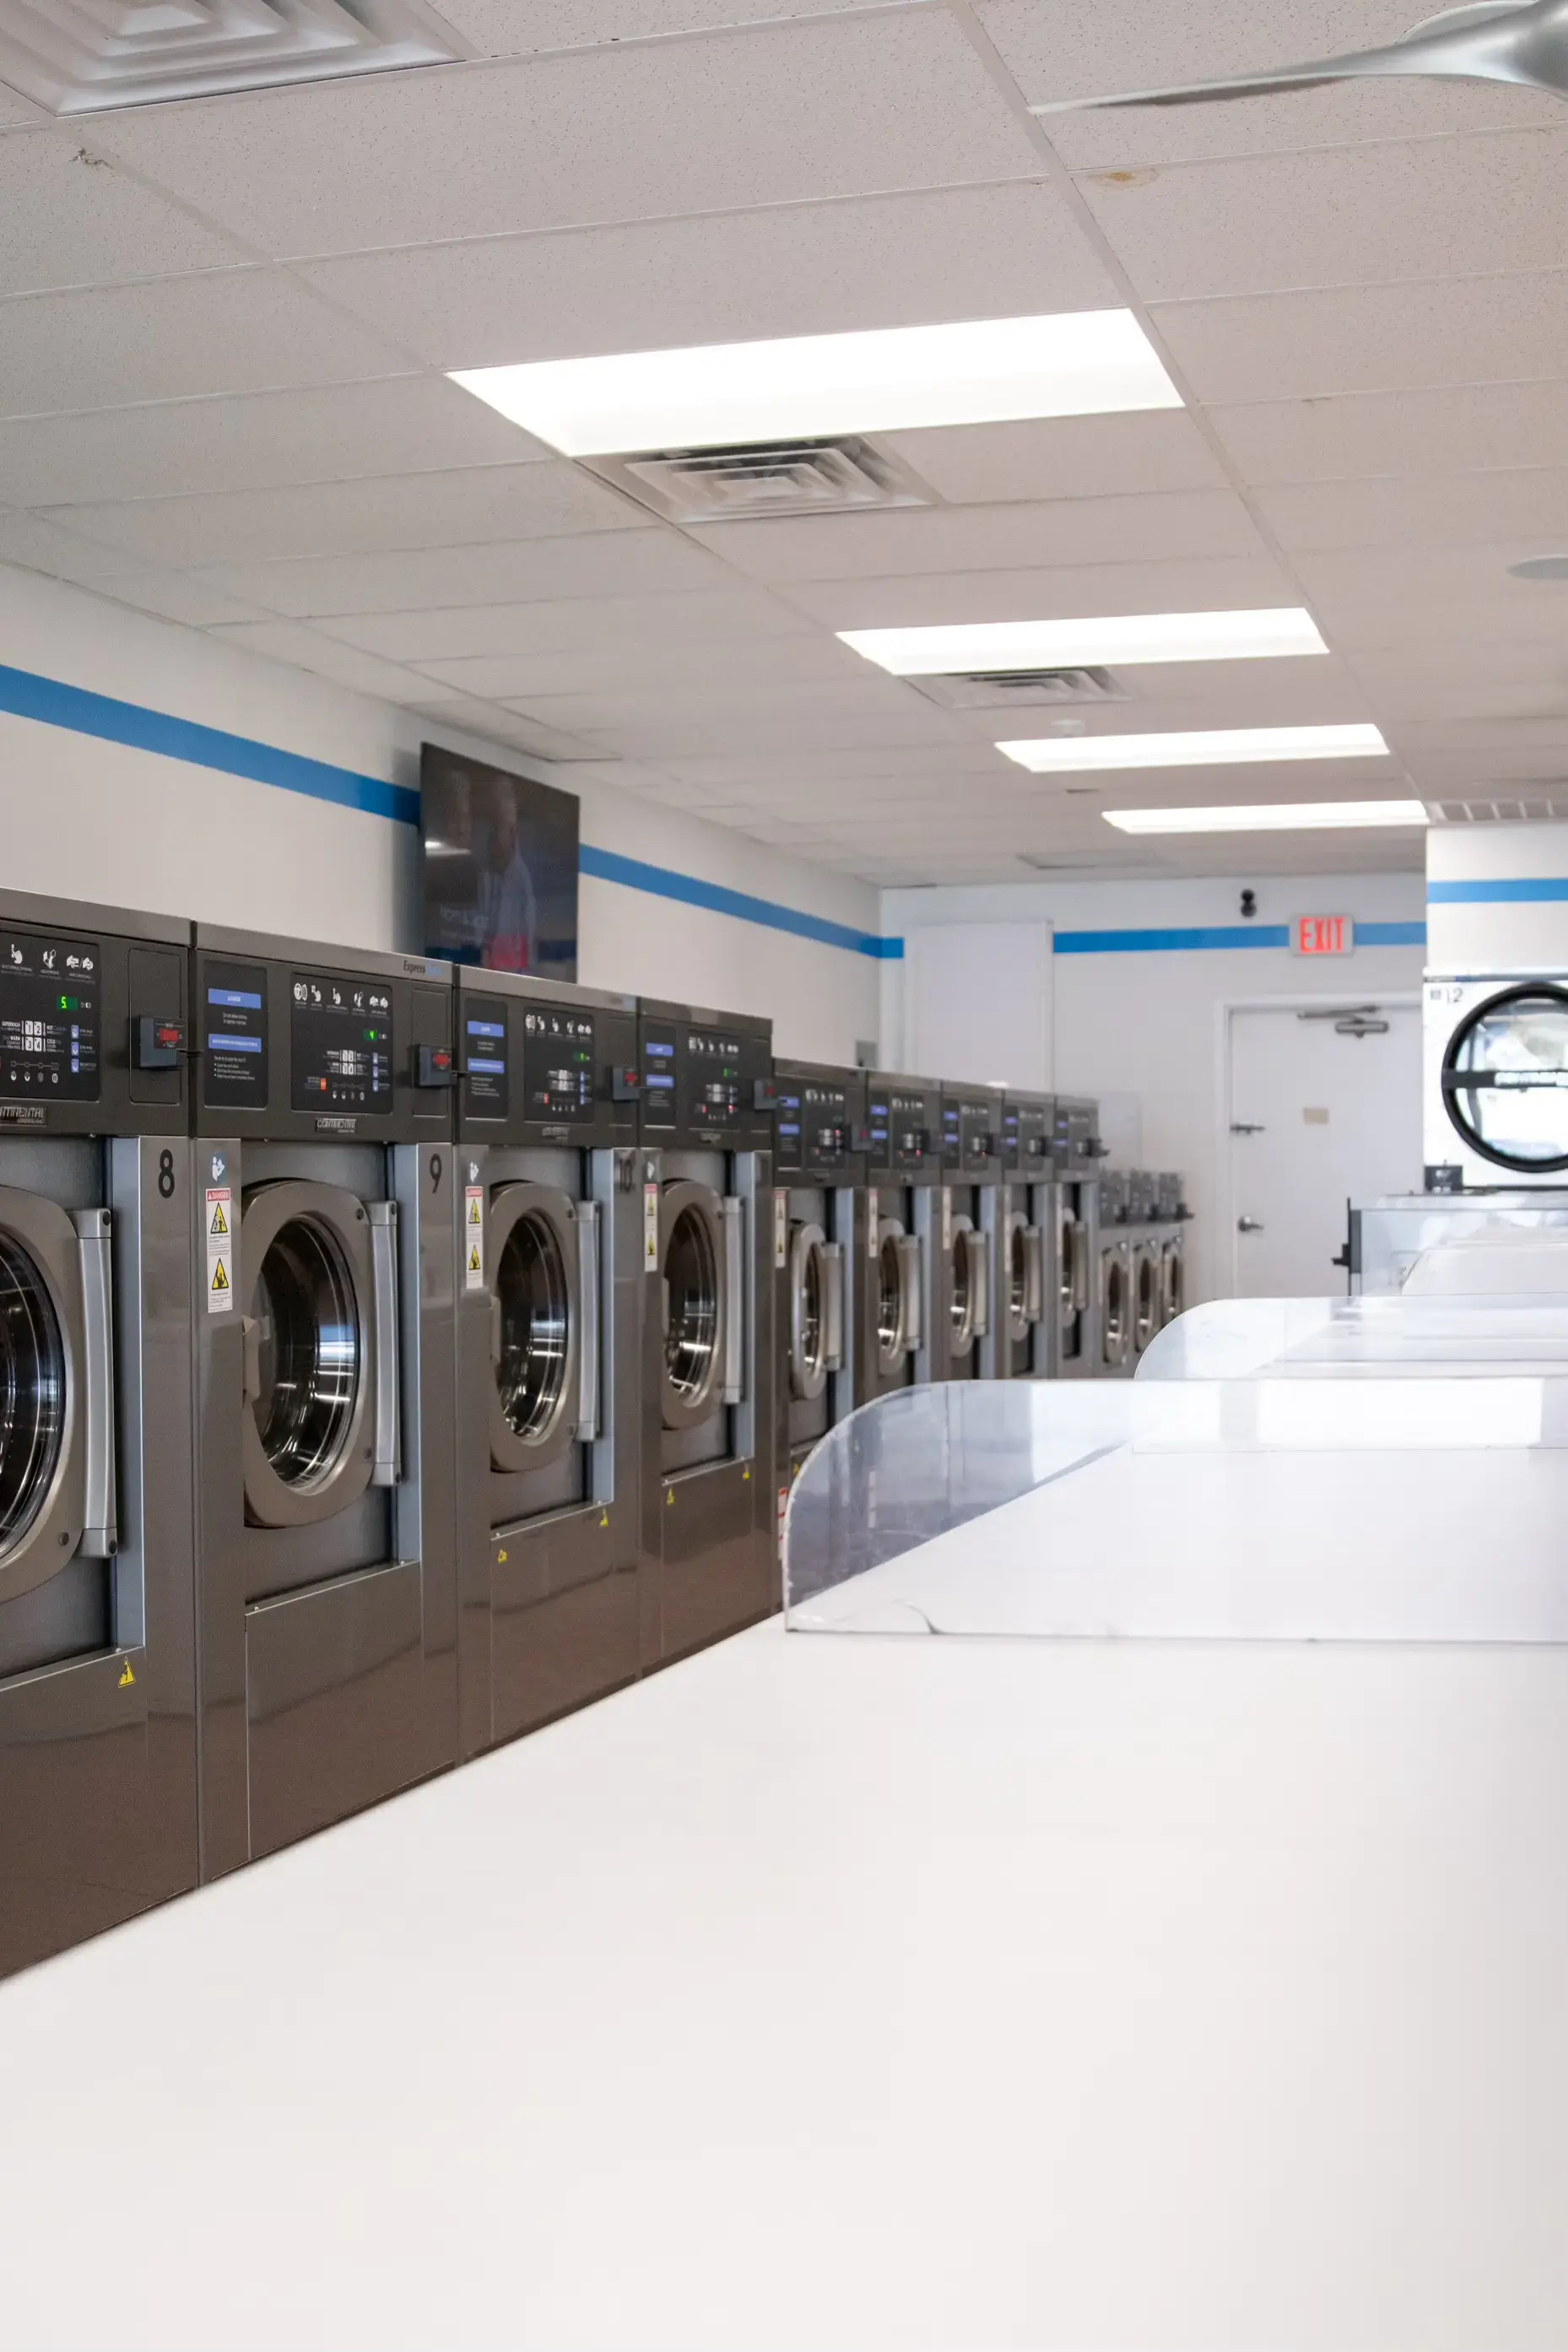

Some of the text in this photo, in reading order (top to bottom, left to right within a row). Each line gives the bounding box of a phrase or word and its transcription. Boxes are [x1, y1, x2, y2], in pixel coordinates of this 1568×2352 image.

[1300, 917, 1344, 953] EXIT
[158, 1149, 176, 1199] 8
[430, 1153, 442, 1194] 9
[618, 1158, 633, 1193] 10
[212, 1190, 230, 1200] DANGER
